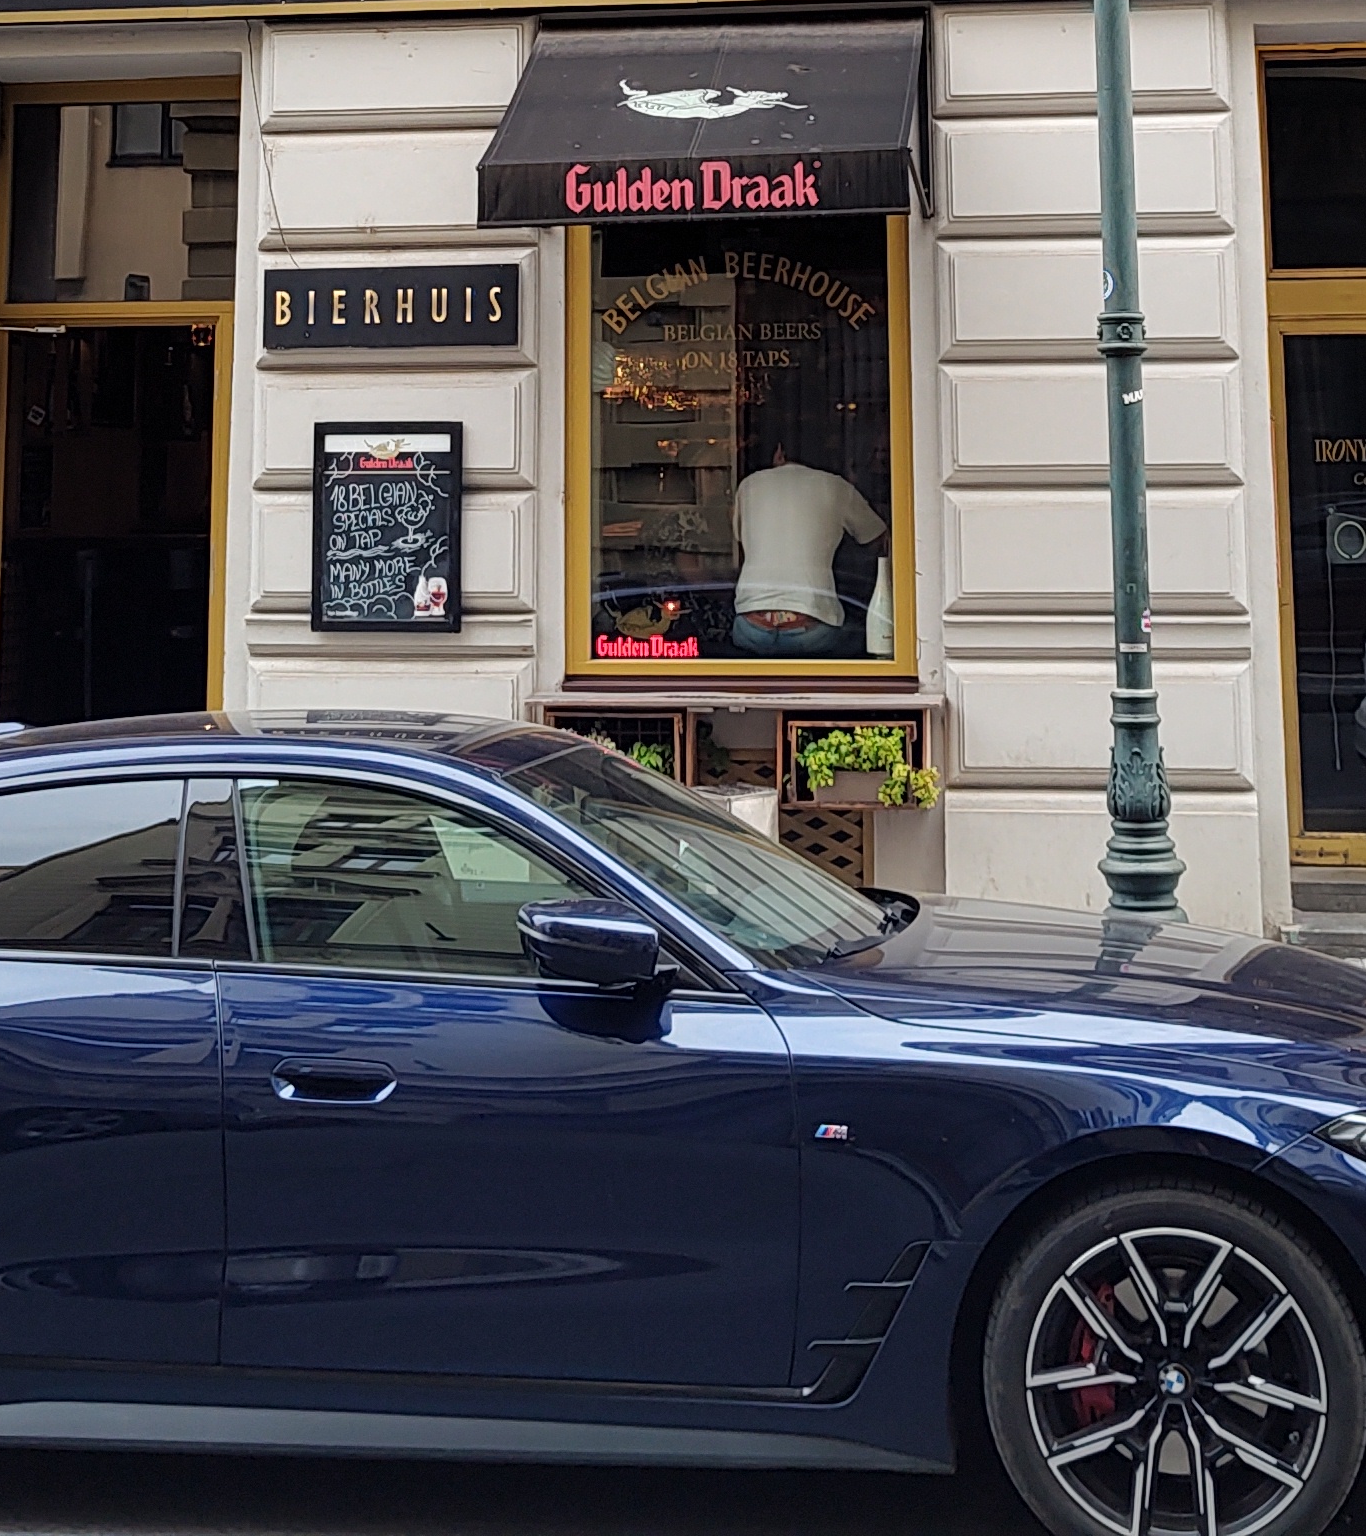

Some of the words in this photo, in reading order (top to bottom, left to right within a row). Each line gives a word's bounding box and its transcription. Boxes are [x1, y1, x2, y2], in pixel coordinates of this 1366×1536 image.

[565, 163, 695, 214] Gulden
[700, 160, 820, 211] Draak
[601, 255, 710, 335] BELGIAN
[724, 251, 876, 331] BEERHOUSE
[275, 286, 502, 326] BIERHUIS
[664, 324, 753, 342] BELGIAN
[760, 322, 822, 340] BEERS
[685, 351, 713, 369] ON
[743, 350, 790, 368] TAPS
[330, 484, 348, 512] 18
[348, 481, 417, 511] BELGIAN
[333, 508, 395, 533] SPECIALS
[329, 534, 347, 550] ON
[350, 529, 382, 548] TAP
[329, 559, 369, 583] MANY
[375, 556, 418, 578] MORE
[330, 583, 344, 599] IN
[348, 575, 406, 600] BOTTLES
[595, 634, 650, 657] Gulden
[650, 634, 699, 657] Draak
